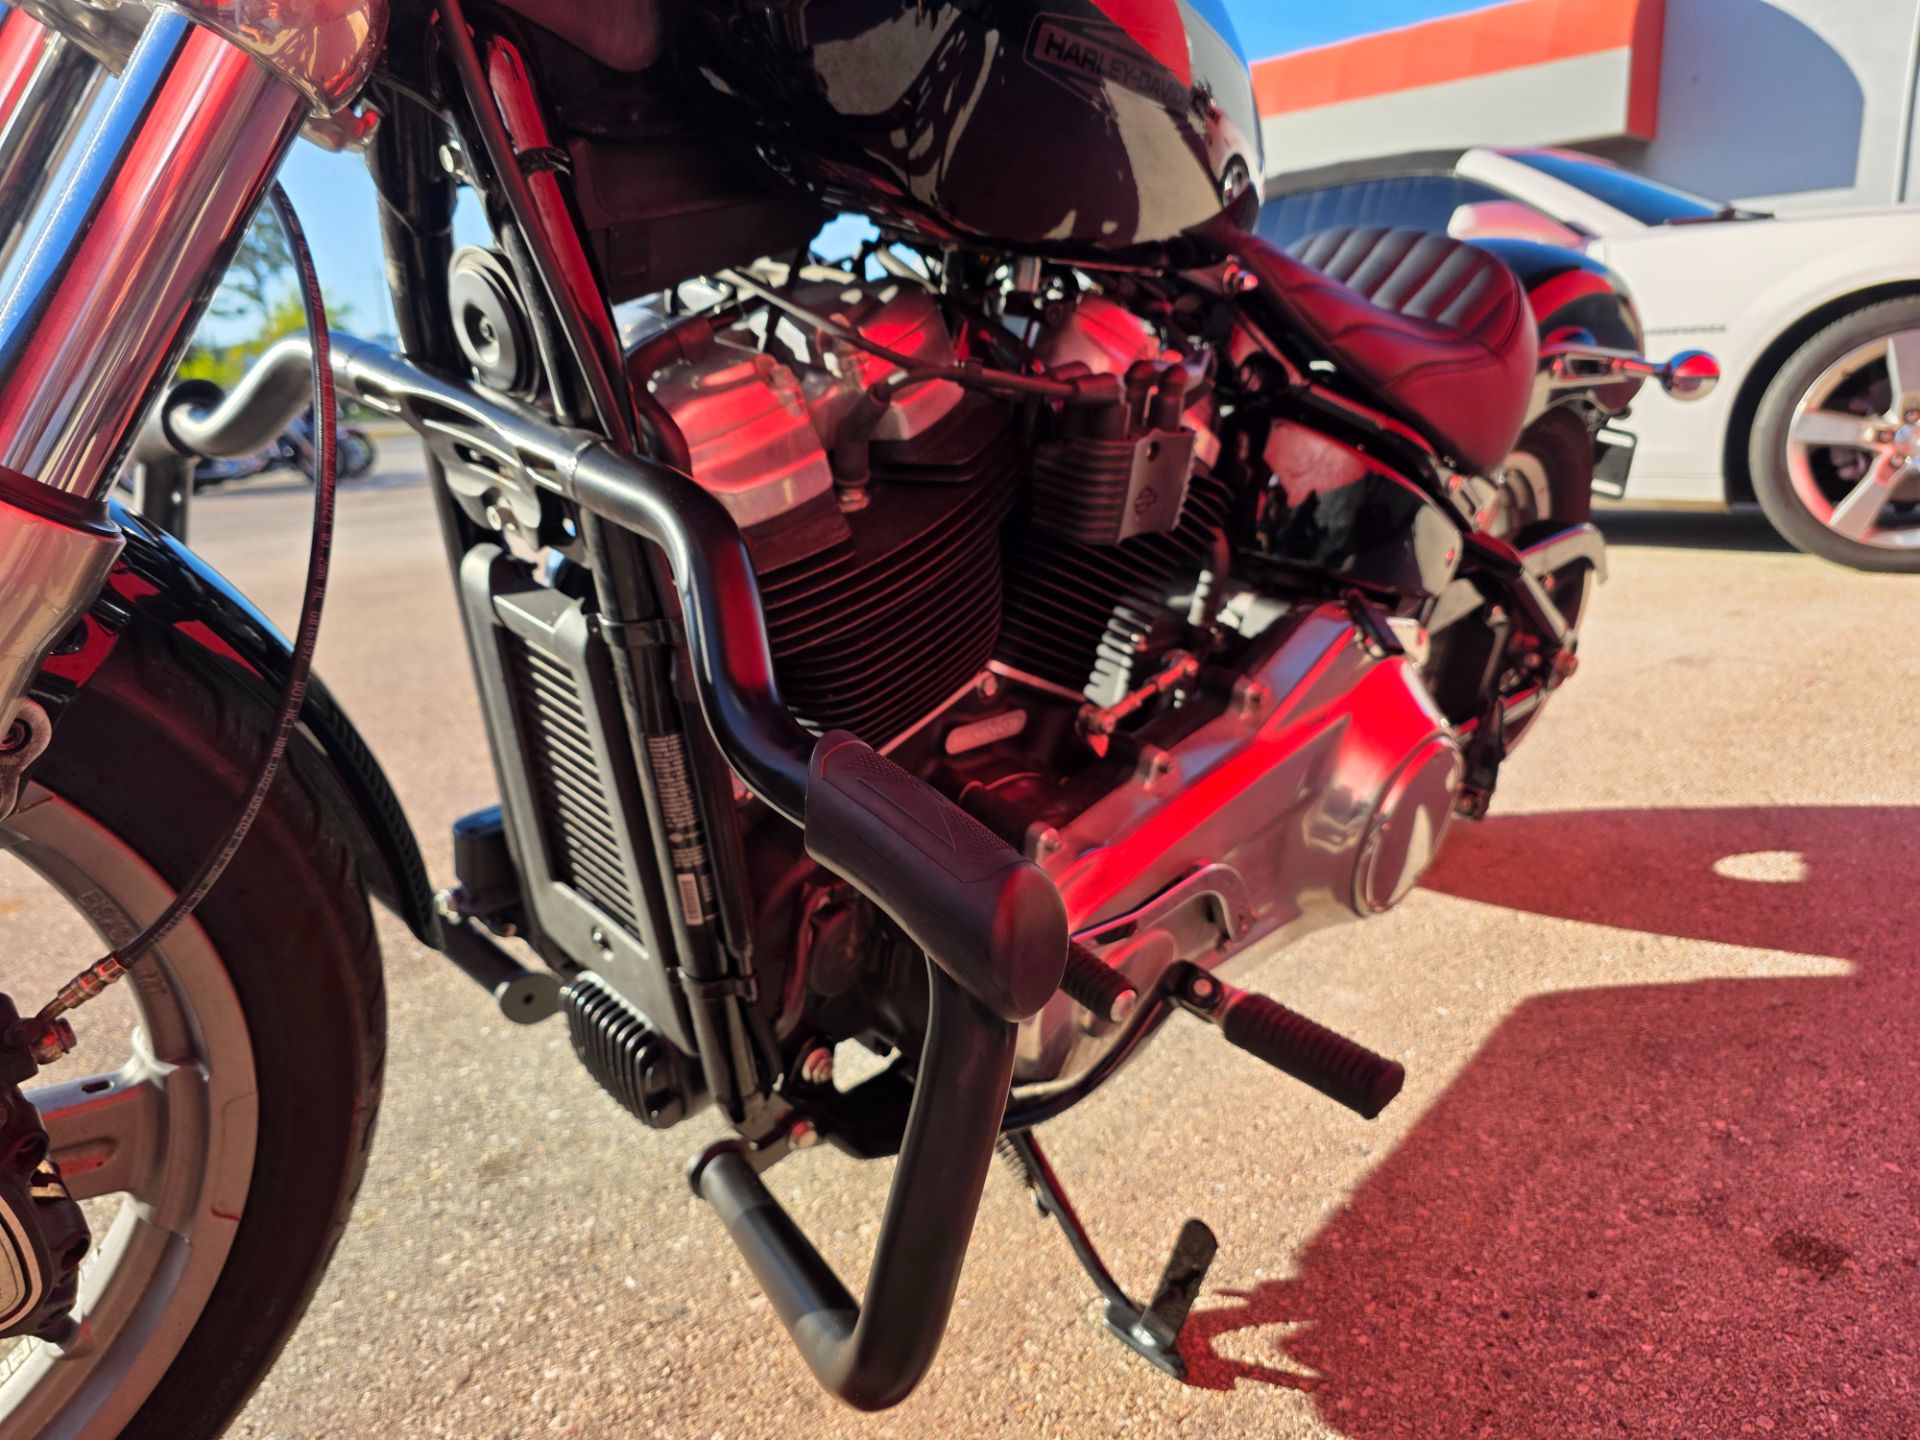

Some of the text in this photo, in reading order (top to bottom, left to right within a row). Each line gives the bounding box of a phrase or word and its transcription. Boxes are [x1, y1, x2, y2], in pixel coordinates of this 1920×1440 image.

[1044, 33, 1189, 108] HARLEY-DAV
[290, 679, 304, 702] DOT
[258, 760, 278, 791] 0302
